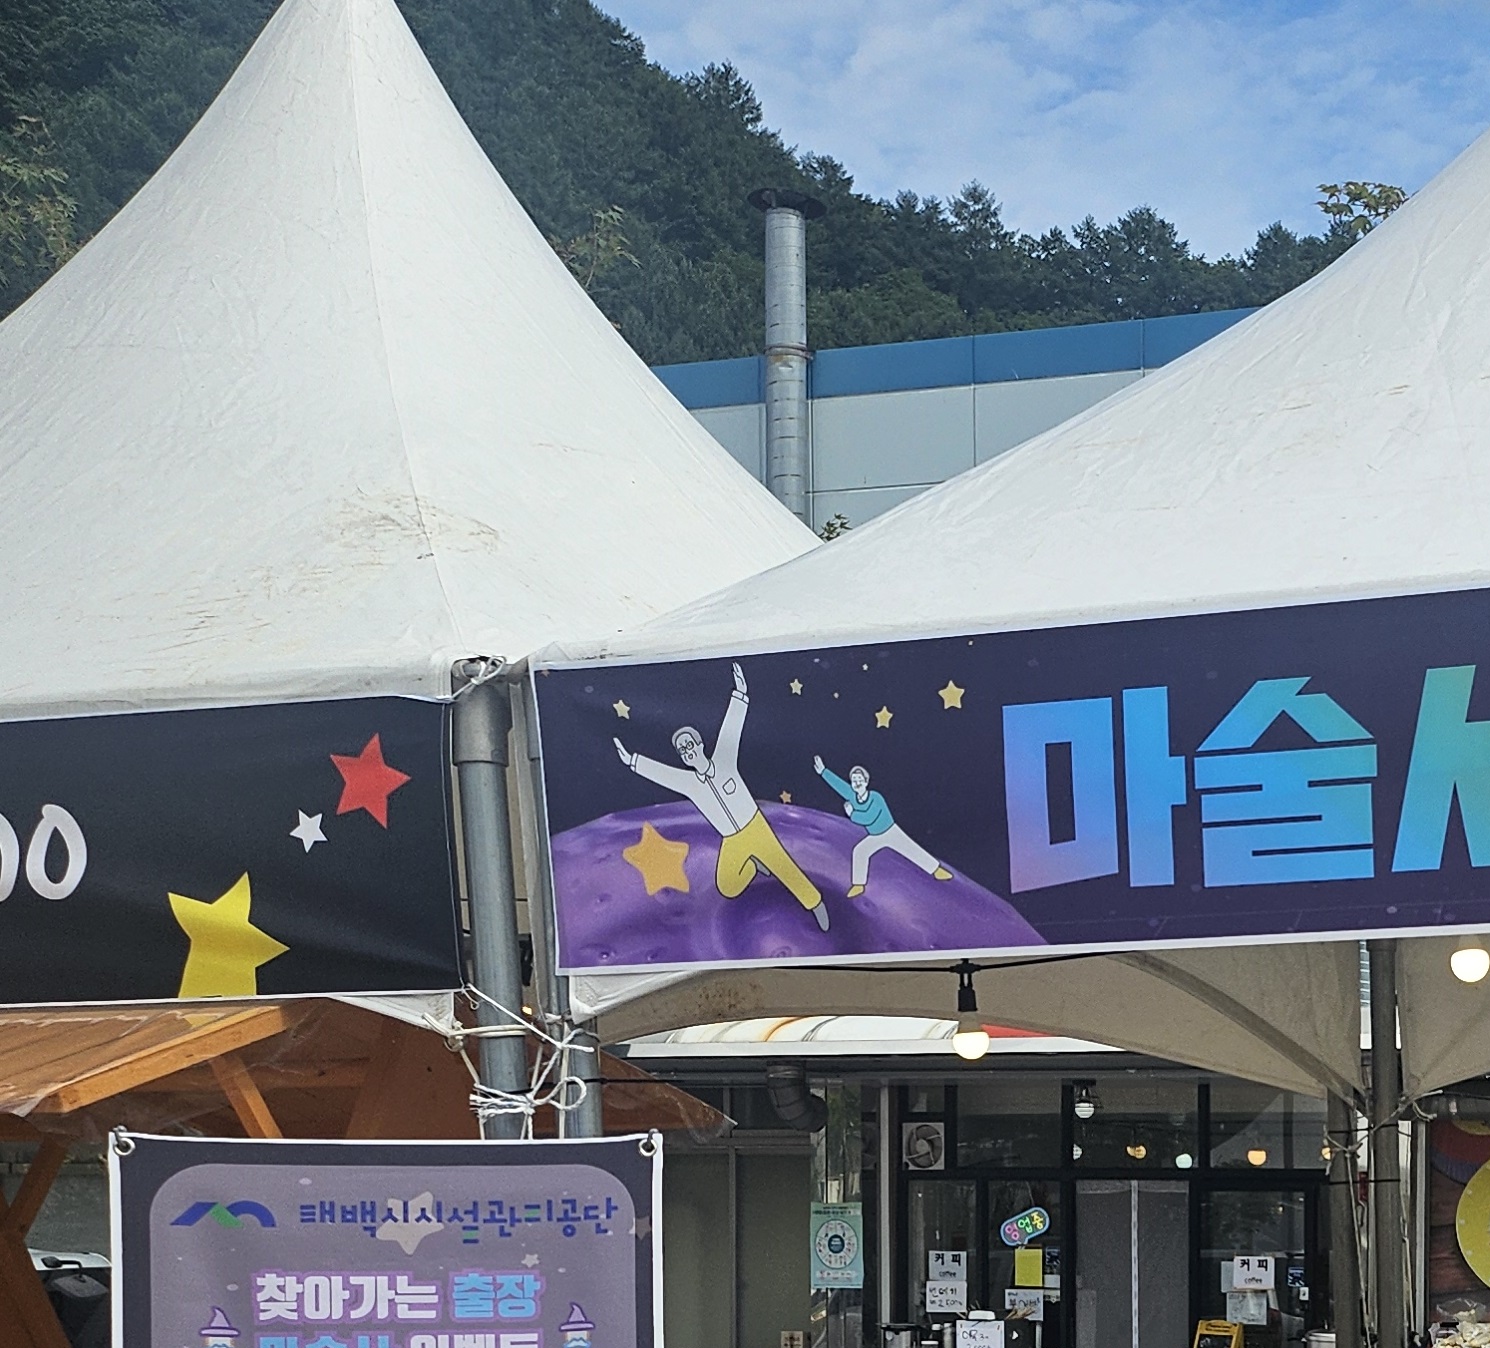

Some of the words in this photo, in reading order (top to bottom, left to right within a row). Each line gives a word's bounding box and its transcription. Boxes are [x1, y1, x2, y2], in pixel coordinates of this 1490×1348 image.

[301, 1197, 618, 1244] 태백시시설관리공단
[256, 1273, 438, 1321] 찾아가는
[453, 1274, 540, 1318] 출장
